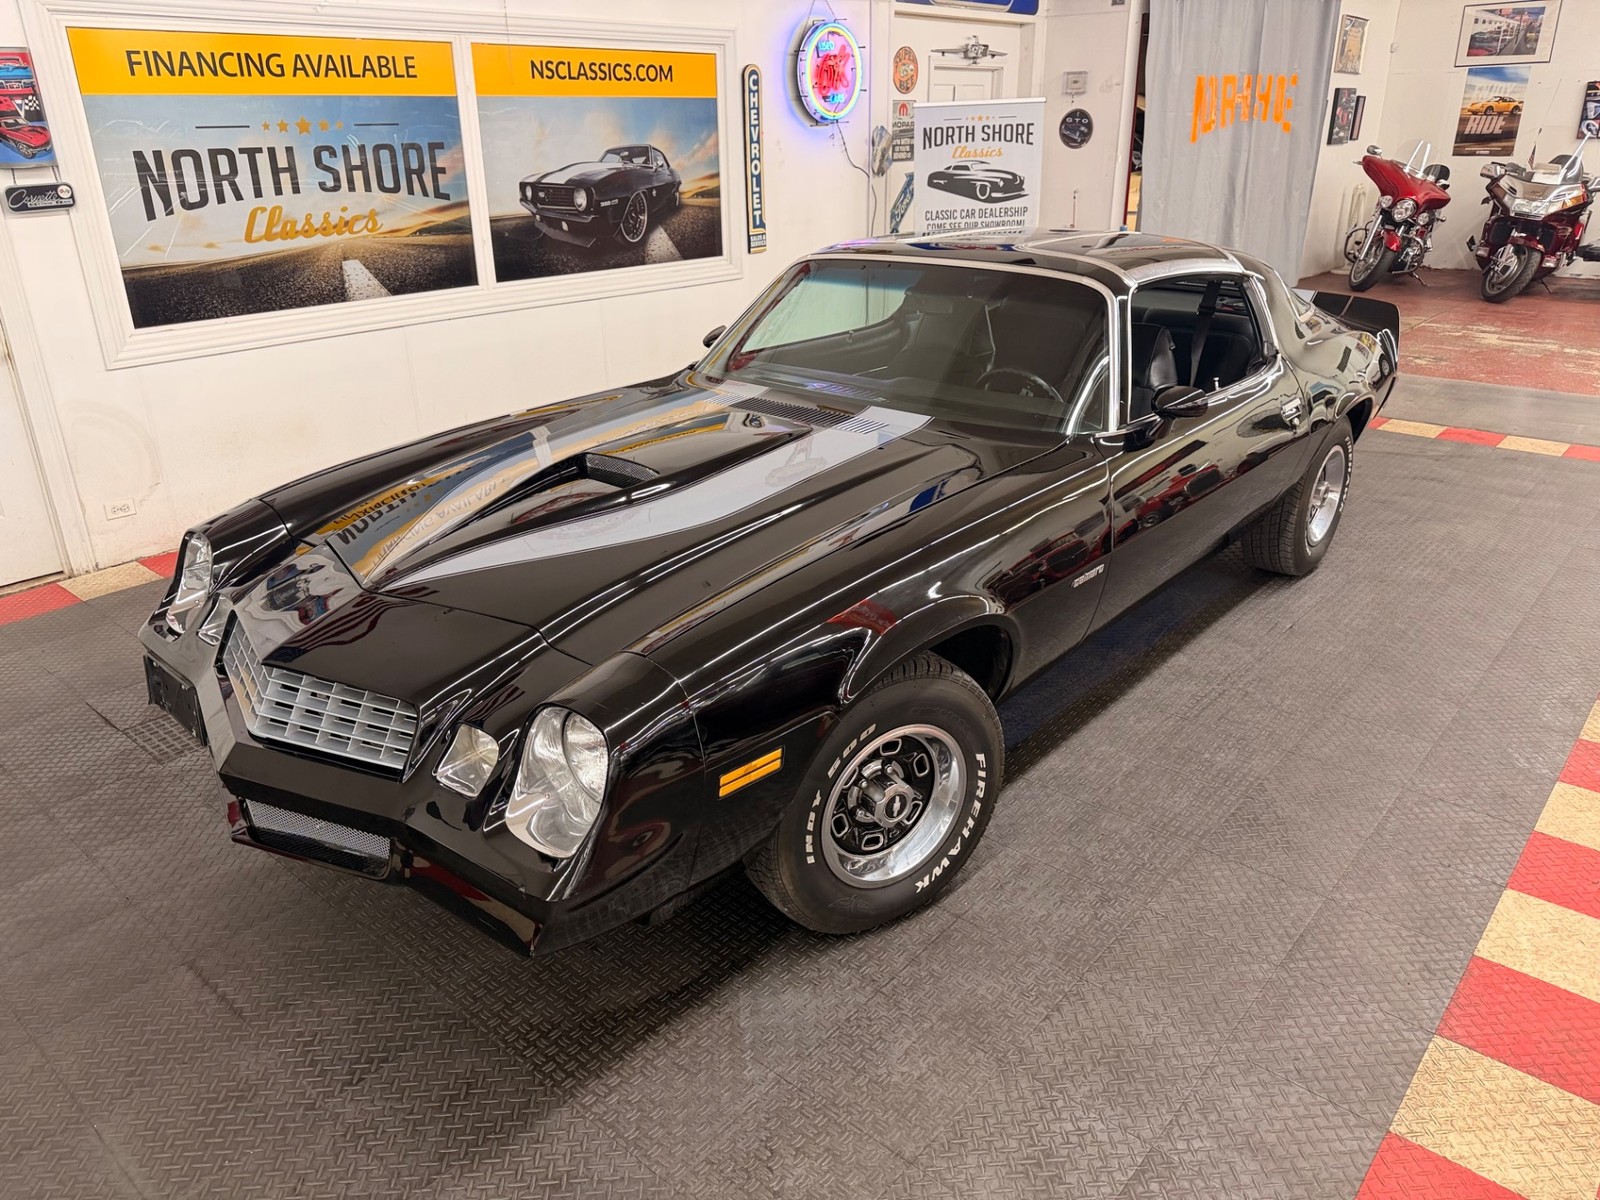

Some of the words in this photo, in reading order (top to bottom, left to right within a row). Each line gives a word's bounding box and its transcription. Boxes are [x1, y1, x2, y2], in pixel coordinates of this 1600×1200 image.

[125, 49, 286, 78] FINANCING
[292, 53, 418, 79] AVAILABLE
[530, 60, 674, 83] NSCLASSICS.COM
[923, 124, 975, 150] NORTH
[981, 123, 1034, 146] SHORE
[1464, 114, 1506, 135] RIDE
[749, 74, 761, 226] CHEVROLET
[952, 145, 1003, 159] Classics
[132, 146, 302, 222] NORTH
[313, 142, 451, 201] SHORE
[9, 188, 60, 208] Corvette
[244, 205, 384, 244] Classics
[925, 209, 958, 221] CLASSIC
[960, 207, 976, 220] CAR
[978, 206, 1028, 219] DEALERSHIP
[805, 789, 822, 864] INDY
[827, 723, 876, 779] 500
[914, 753, 987, 893] FIREHAWK
